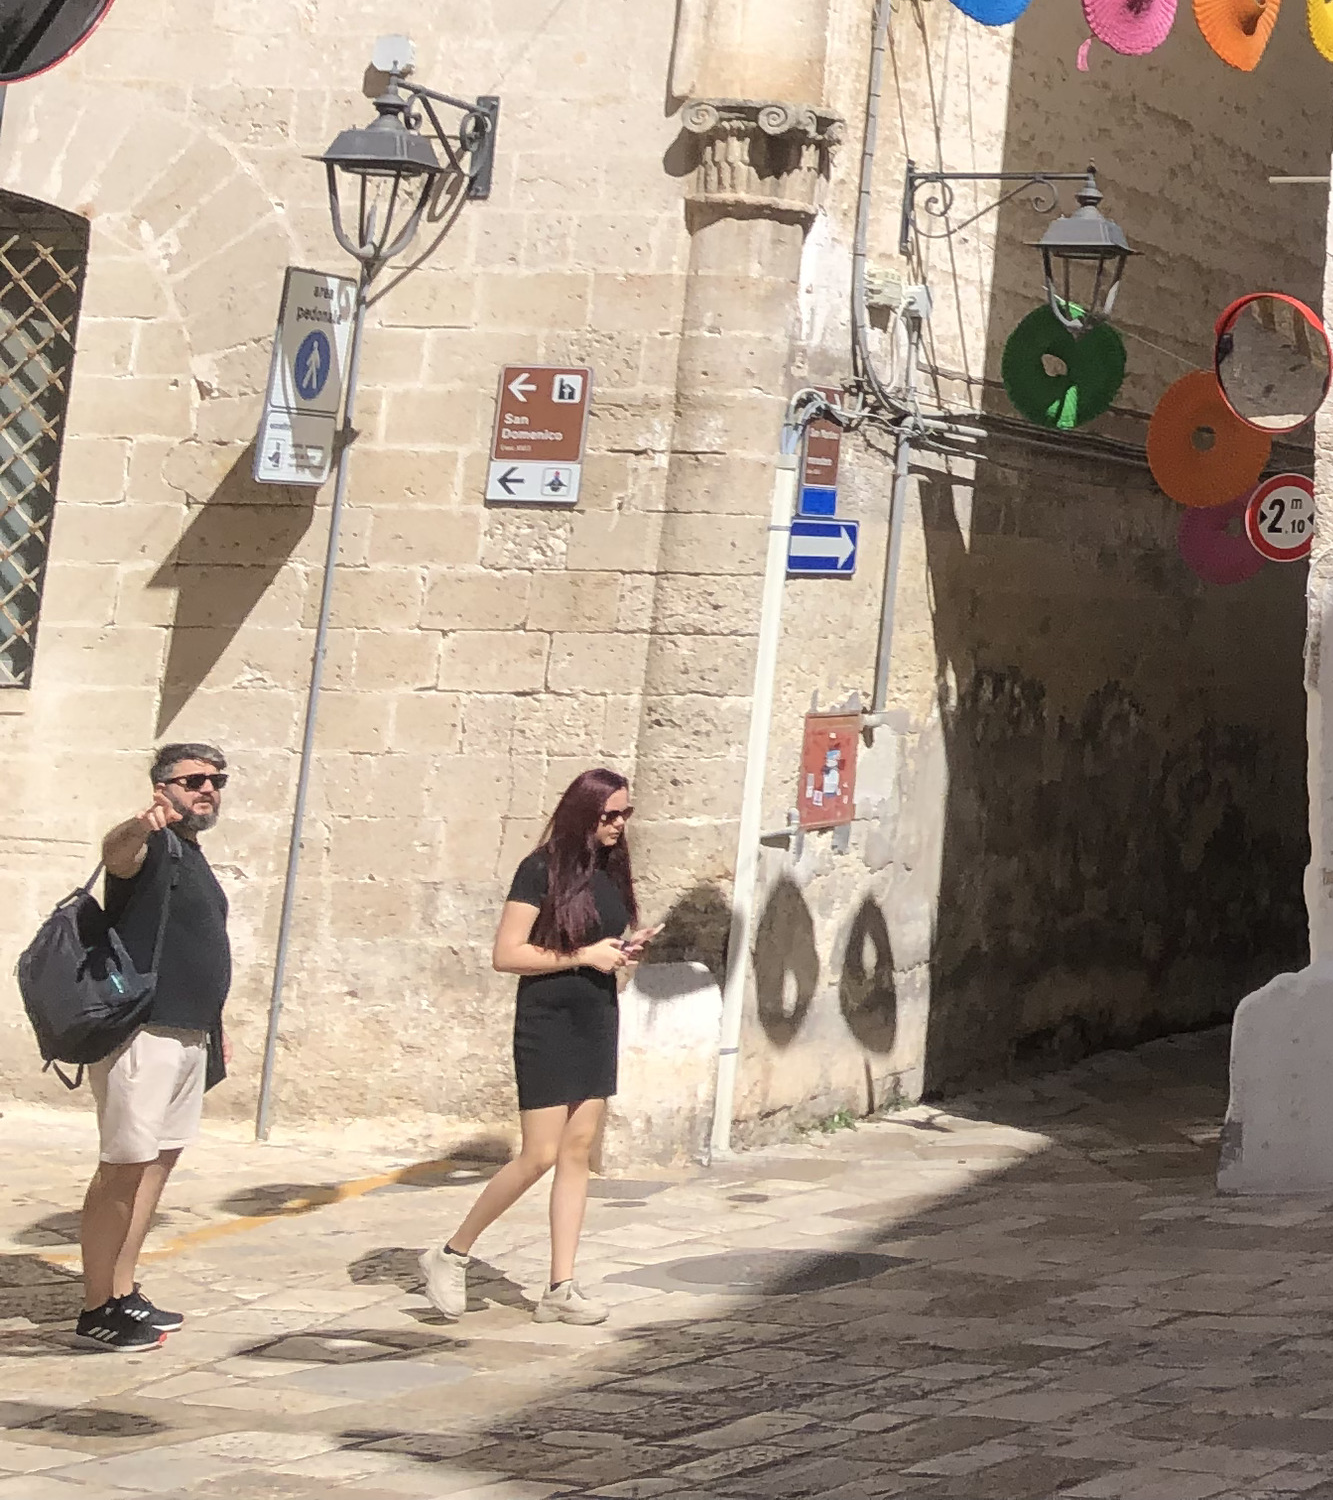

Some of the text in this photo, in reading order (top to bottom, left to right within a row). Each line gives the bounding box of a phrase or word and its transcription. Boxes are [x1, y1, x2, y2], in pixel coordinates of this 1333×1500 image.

[313, 286, 334, 300] area
[503, 412, 530, 425] San
[501, 427, 564, 441] Domenico
[1290, 498, 1303, 510] m
